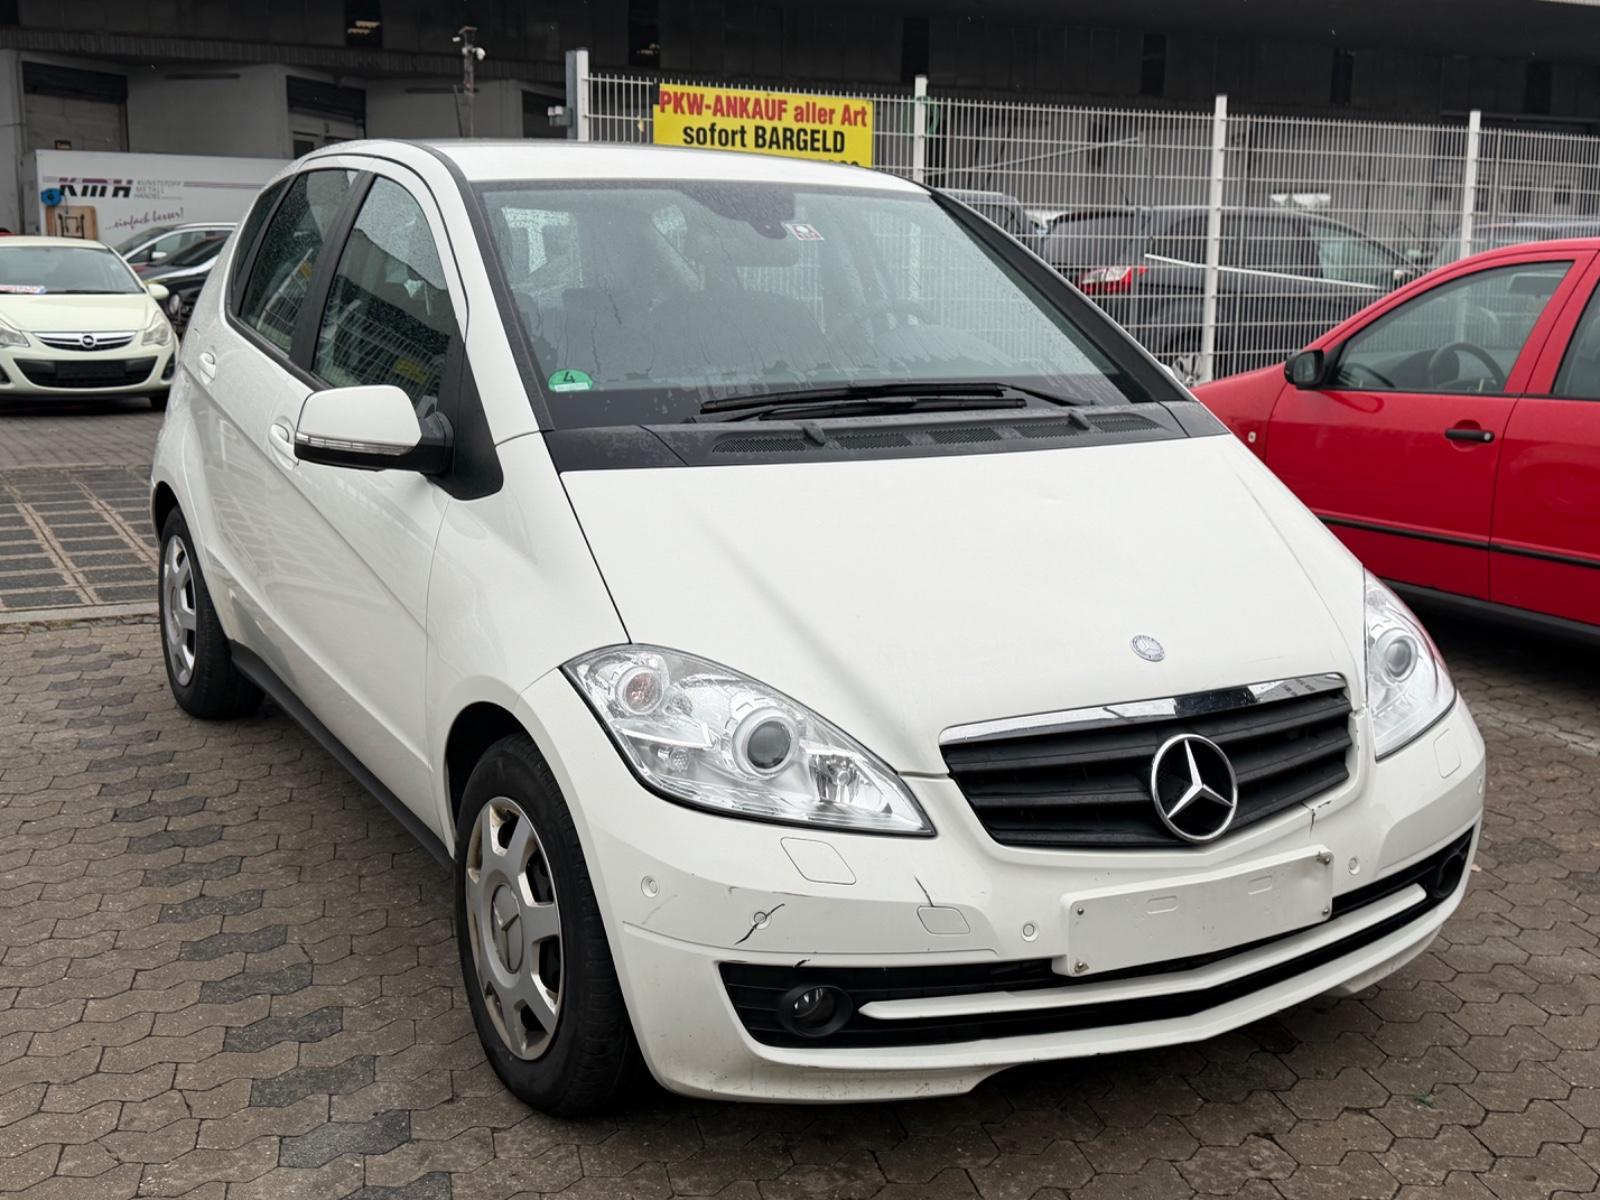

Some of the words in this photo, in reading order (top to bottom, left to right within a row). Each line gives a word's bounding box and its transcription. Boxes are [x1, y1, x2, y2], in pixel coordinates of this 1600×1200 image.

[659, 90, 788, 121] PKW-ANKAUF
[793, 101, 835, 125] aller
[841, 104, 868, 128] Art
[683, 122, 747, 147] sofort
[754, 126, 845, 153] BARGELD
[563, 371, 576, 383] 4
